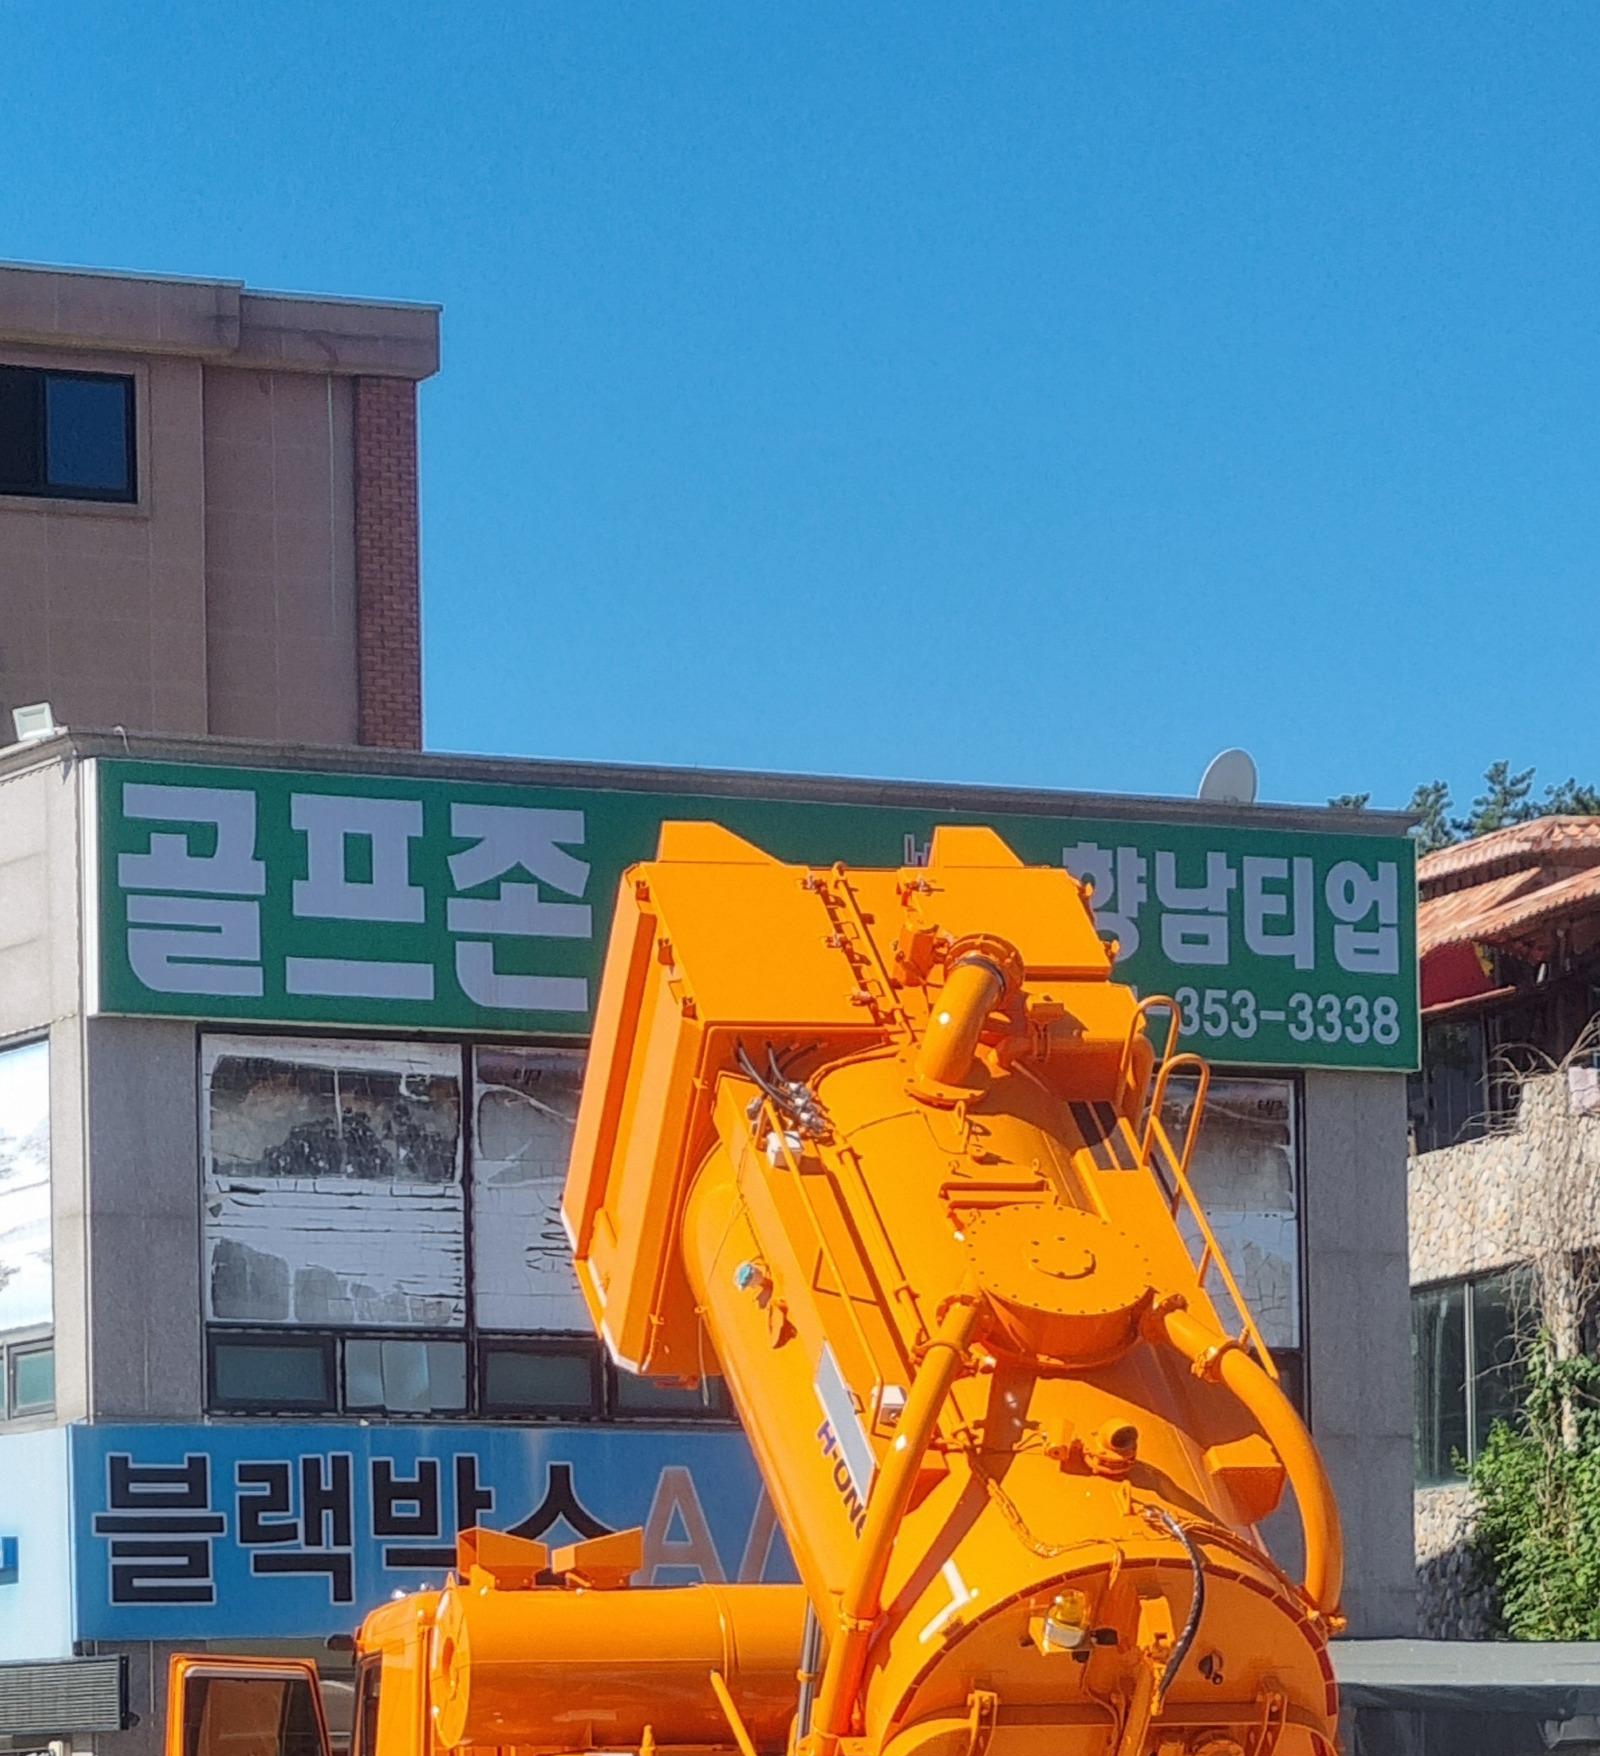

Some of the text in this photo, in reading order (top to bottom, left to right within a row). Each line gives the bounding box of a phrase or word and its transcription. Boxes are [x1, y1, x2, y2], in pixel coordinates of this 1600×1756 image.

[118, 781, 592, 1012] 골프존
[1062, 842, 1399, 975] 향남티업
[92, 1452, 622, 1605] 블랙박스
